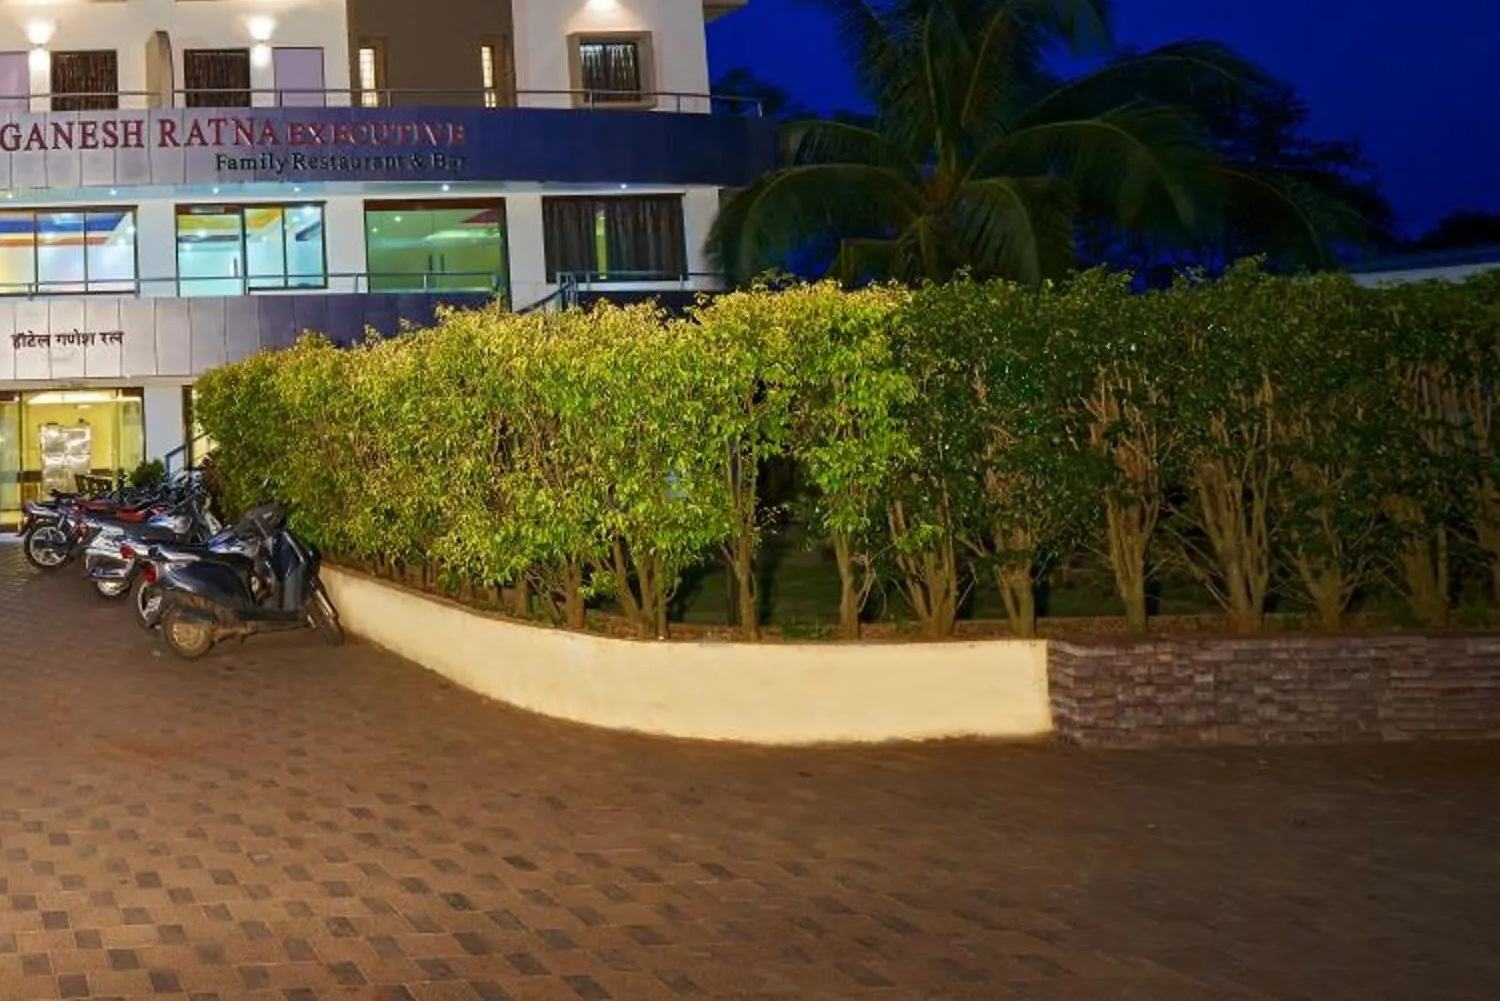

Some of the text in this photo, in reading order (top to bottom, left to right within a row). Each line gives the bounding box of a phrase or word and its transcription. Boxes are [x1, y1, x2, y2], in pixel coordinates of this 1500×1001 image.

[157, 117, 281, 149] RATNA
[286, 120, 467, 148] EXECUTIVE
[214, 152, 288, 173] Family
[292, 150, 402, 171] Restaurant
[409, 152, 425, 168] &
[54, 328, 96, 347] गणेश
